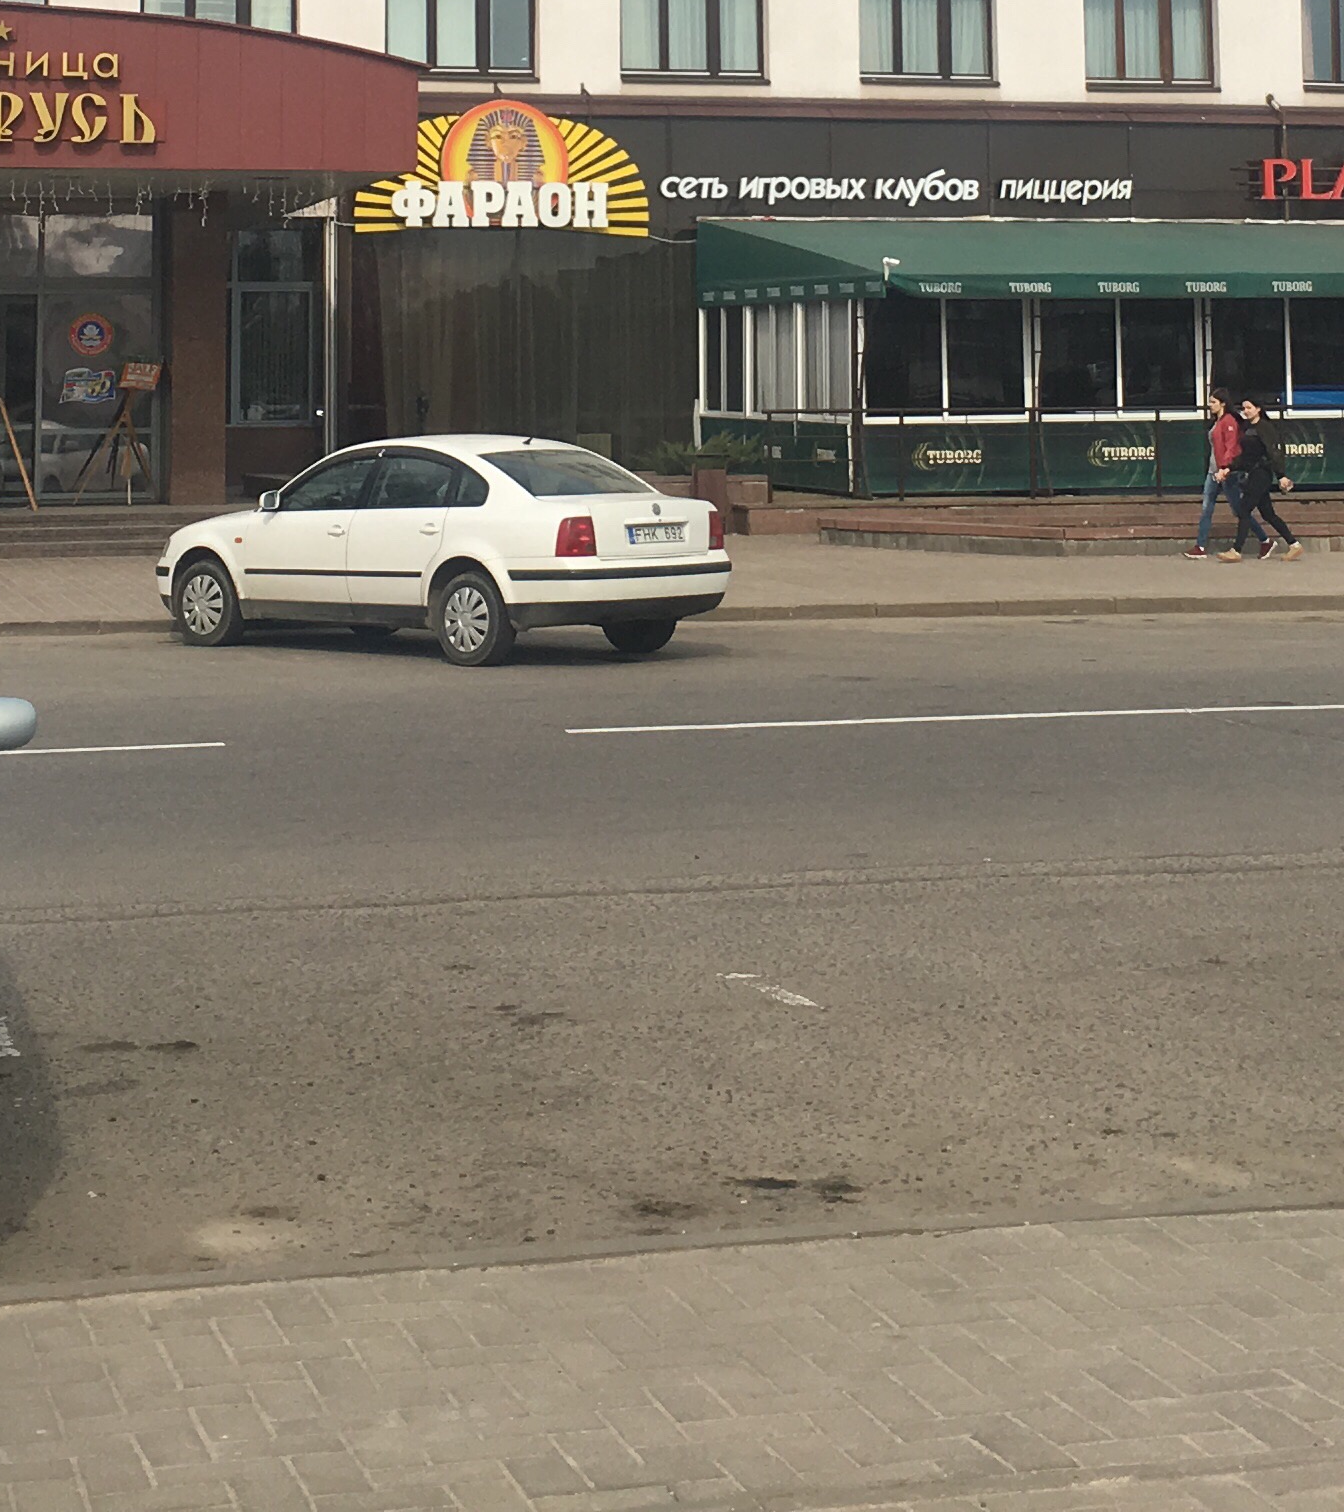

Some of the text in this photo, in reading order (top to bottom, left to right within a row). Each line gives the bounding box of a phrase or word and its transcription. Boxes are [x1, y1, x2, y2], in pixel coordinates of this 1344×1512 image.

[660, 169, 980, 207] сеть игровых клубов
[999, 176, 1133, 205] пиццерия
[391, 180, 609, 228] ФАРАОН
[918, 281, 962, 294] TUBORG
[1008, 281, 1052, 293] TUBORG
[1097, 281, 1140, 293] TUBORG
[1185, 281, 1227, 293] TUBORG
[1271, 280, 1313, 293] TUBORG
[927, 449, 982, 464] TUBORG
[1101, 446, 1155, 460] TUBORG
[1277, 443, 1324, 457] BORG
[664, 527, 684, 540] 692
